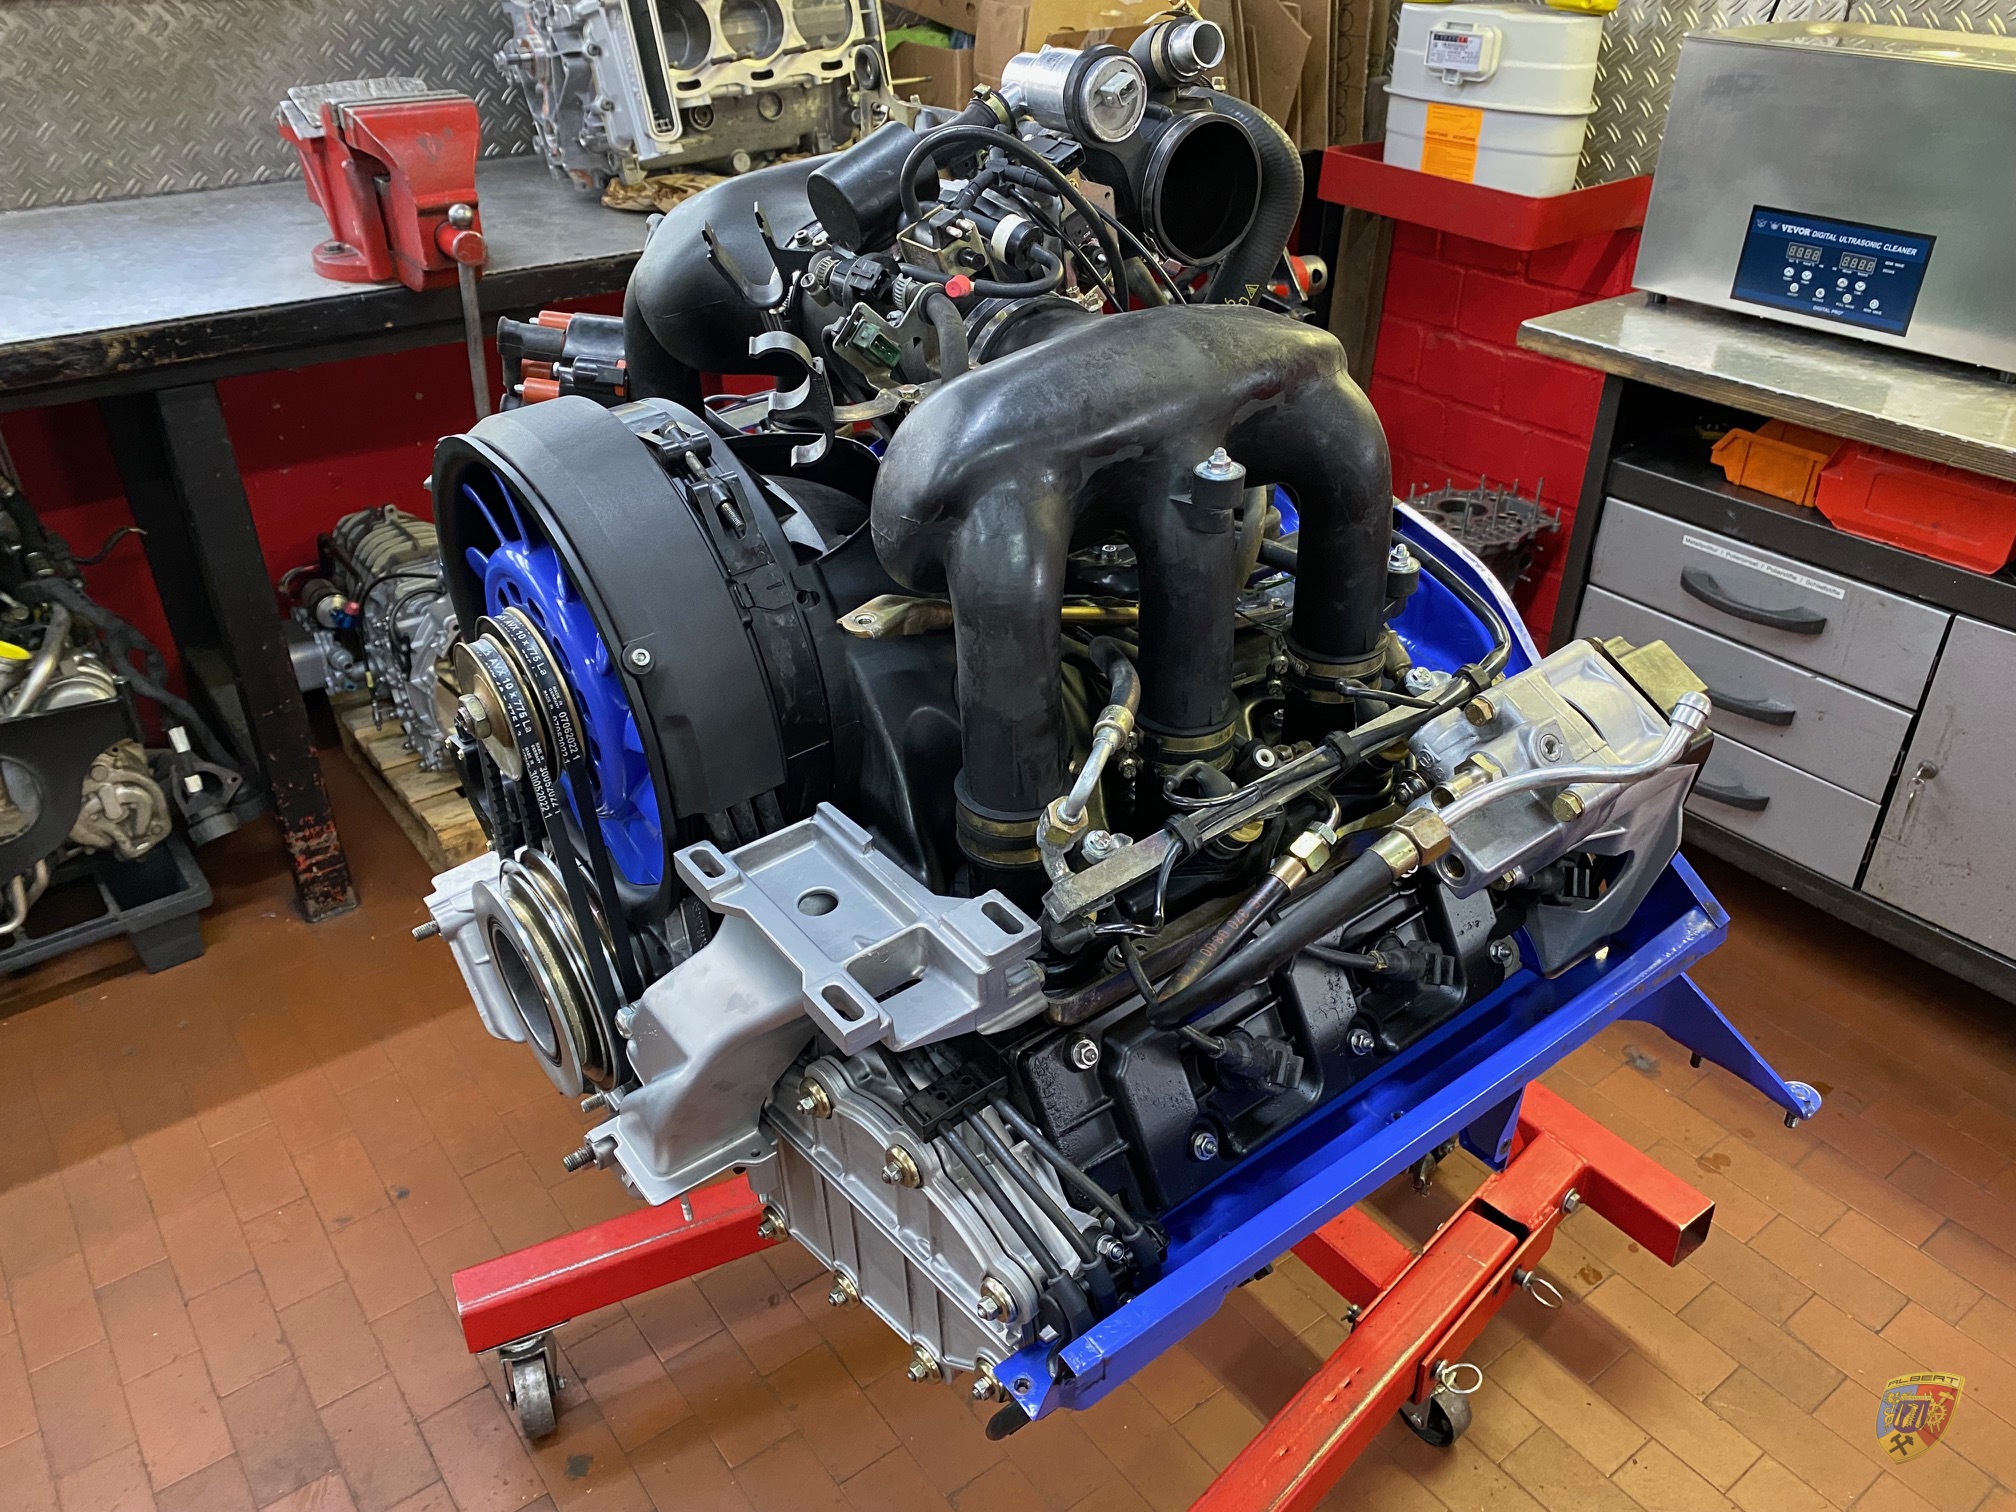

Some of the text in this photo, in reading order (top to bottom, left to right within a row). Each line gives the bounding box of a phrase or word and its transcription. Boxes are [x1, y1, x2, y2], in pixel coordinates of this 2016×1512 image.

[1781, 224, 1918, 256] VEVOR DIGITAL ULTRASONIC CLEANER
[536, 662, 547, 676] La
[488, 658, 506, 676] AVX
[502, 678, 514, 690] 10
[514, 700, 528, 719] 775
[522, 720, 532, 734] La
[559, 711, 578, 754] 07062022
[530, 770, 550, 812] 30052022
